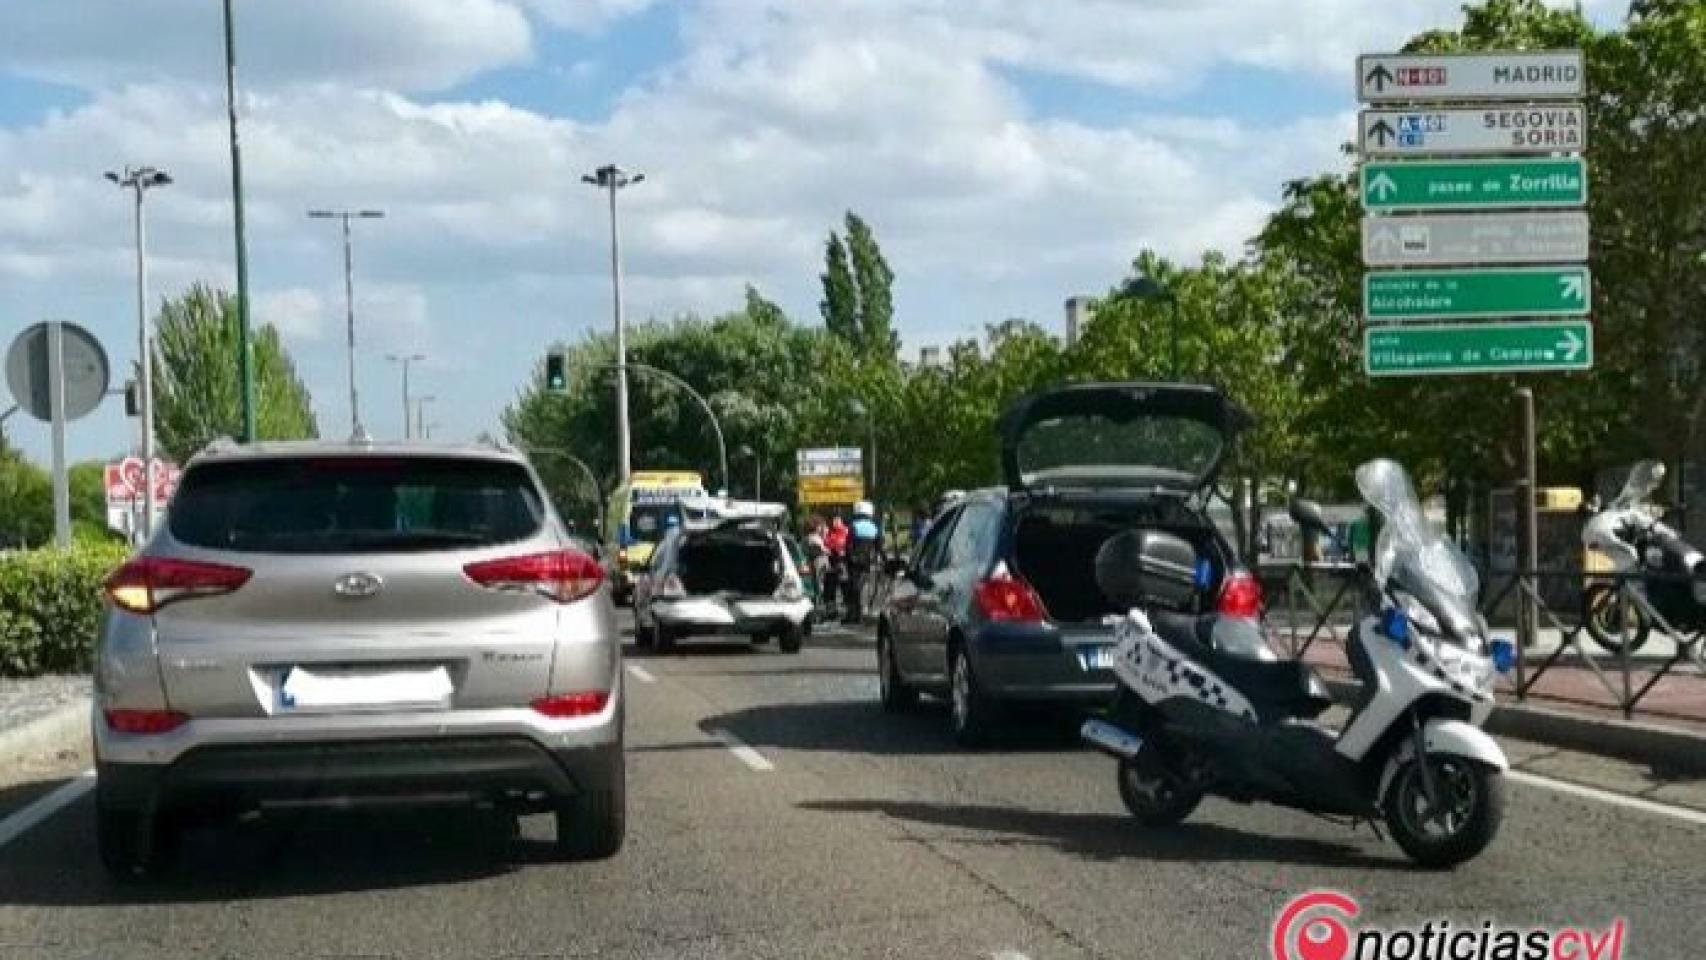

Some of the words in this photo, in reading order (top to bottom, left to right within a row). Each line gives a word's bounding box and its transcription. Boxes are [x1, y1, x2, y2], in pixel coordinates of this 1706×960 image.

[1493, 65, 1577, 84] MADRID
[1483, 111, 1577, 128] SEGOVIA
[1511, 129, 1577, 145] SORIA
[1482, 178, 1501, 192] de
[1508, 173, 1580, 192] Zorrilla
[1461, 349, 1482, 361] de
